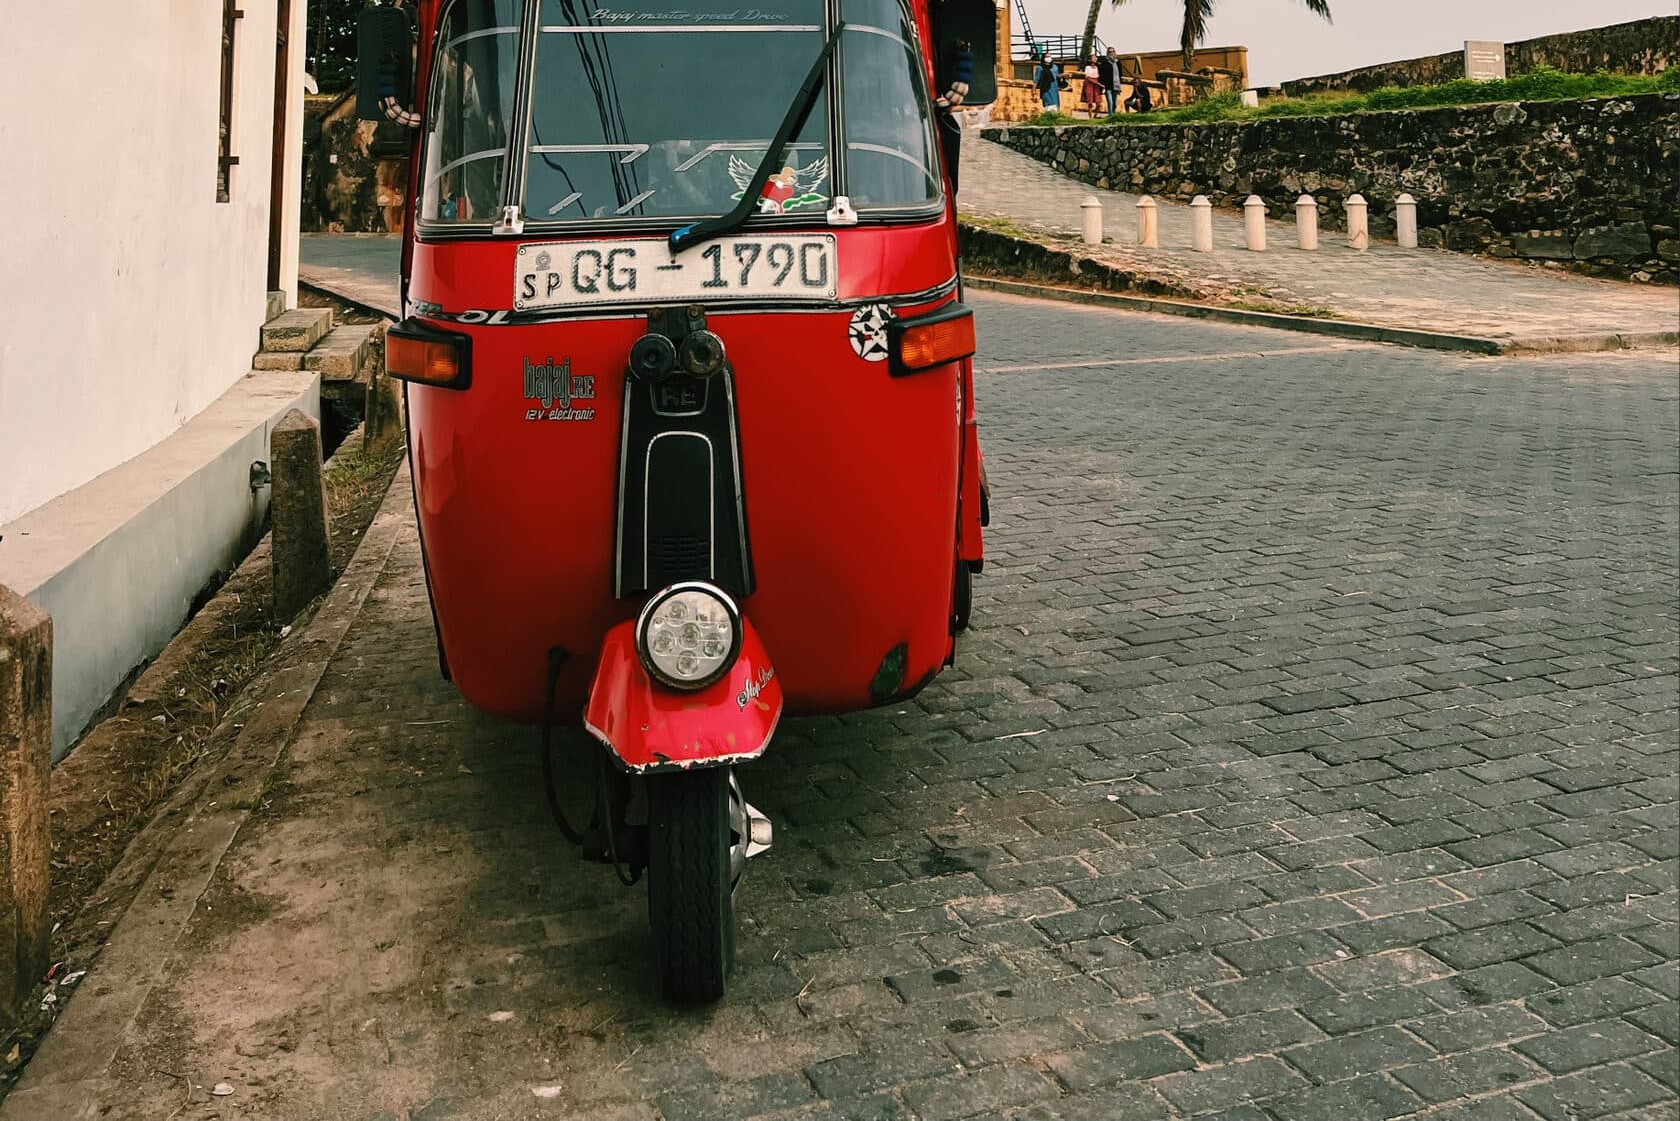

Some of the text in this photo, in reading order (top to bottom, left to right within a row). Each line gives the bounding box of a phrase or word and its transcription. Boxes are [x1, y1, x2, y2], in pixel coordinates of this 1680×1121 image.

[590, 8, 638, 22] Bajaj
[638, 10, 691, 20] master
[572, 248, 636, 294] QG
[702, 242, 827, 288] 1790
[548, 406, 595, 420] electronic
